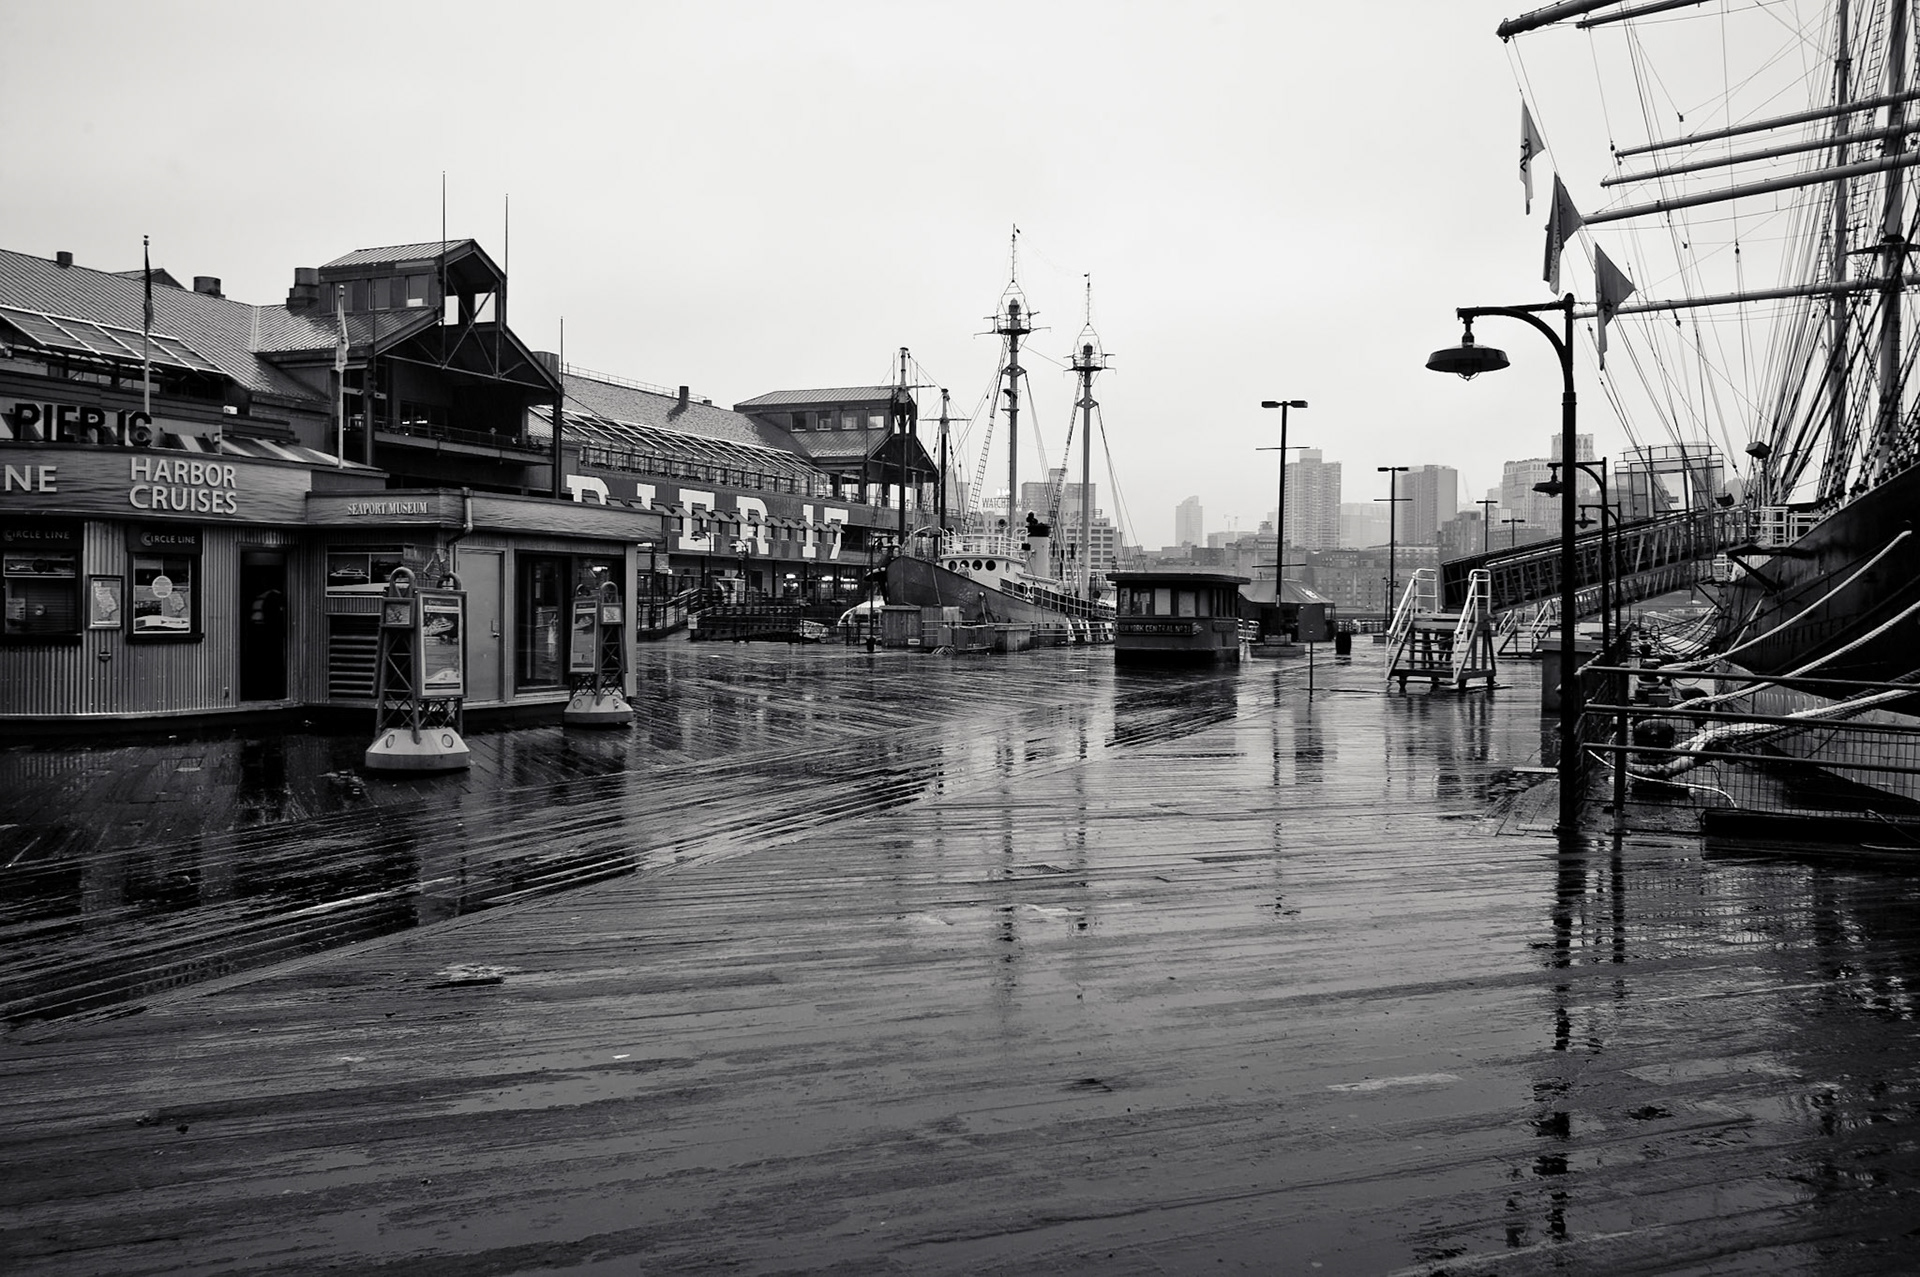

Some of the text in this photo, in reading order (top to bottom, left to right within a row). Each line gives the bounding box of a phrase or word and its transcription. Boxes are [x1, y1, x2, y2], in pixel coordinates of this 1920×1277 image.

[13, 402, 152, 447] PIER 16
[4, 464, 58, 493] NE
[130, 456, 237, 489] HARBOR
[129, 484, 238, 515] CRUISES
[347, 501, 429, 516] SEAPORT MUSEUM
[2, 528, 71, 542] CIRCLE LINE
[141, 531, 196, 547] CIRCLE LINE
[802, 504, 849, 559] 17
